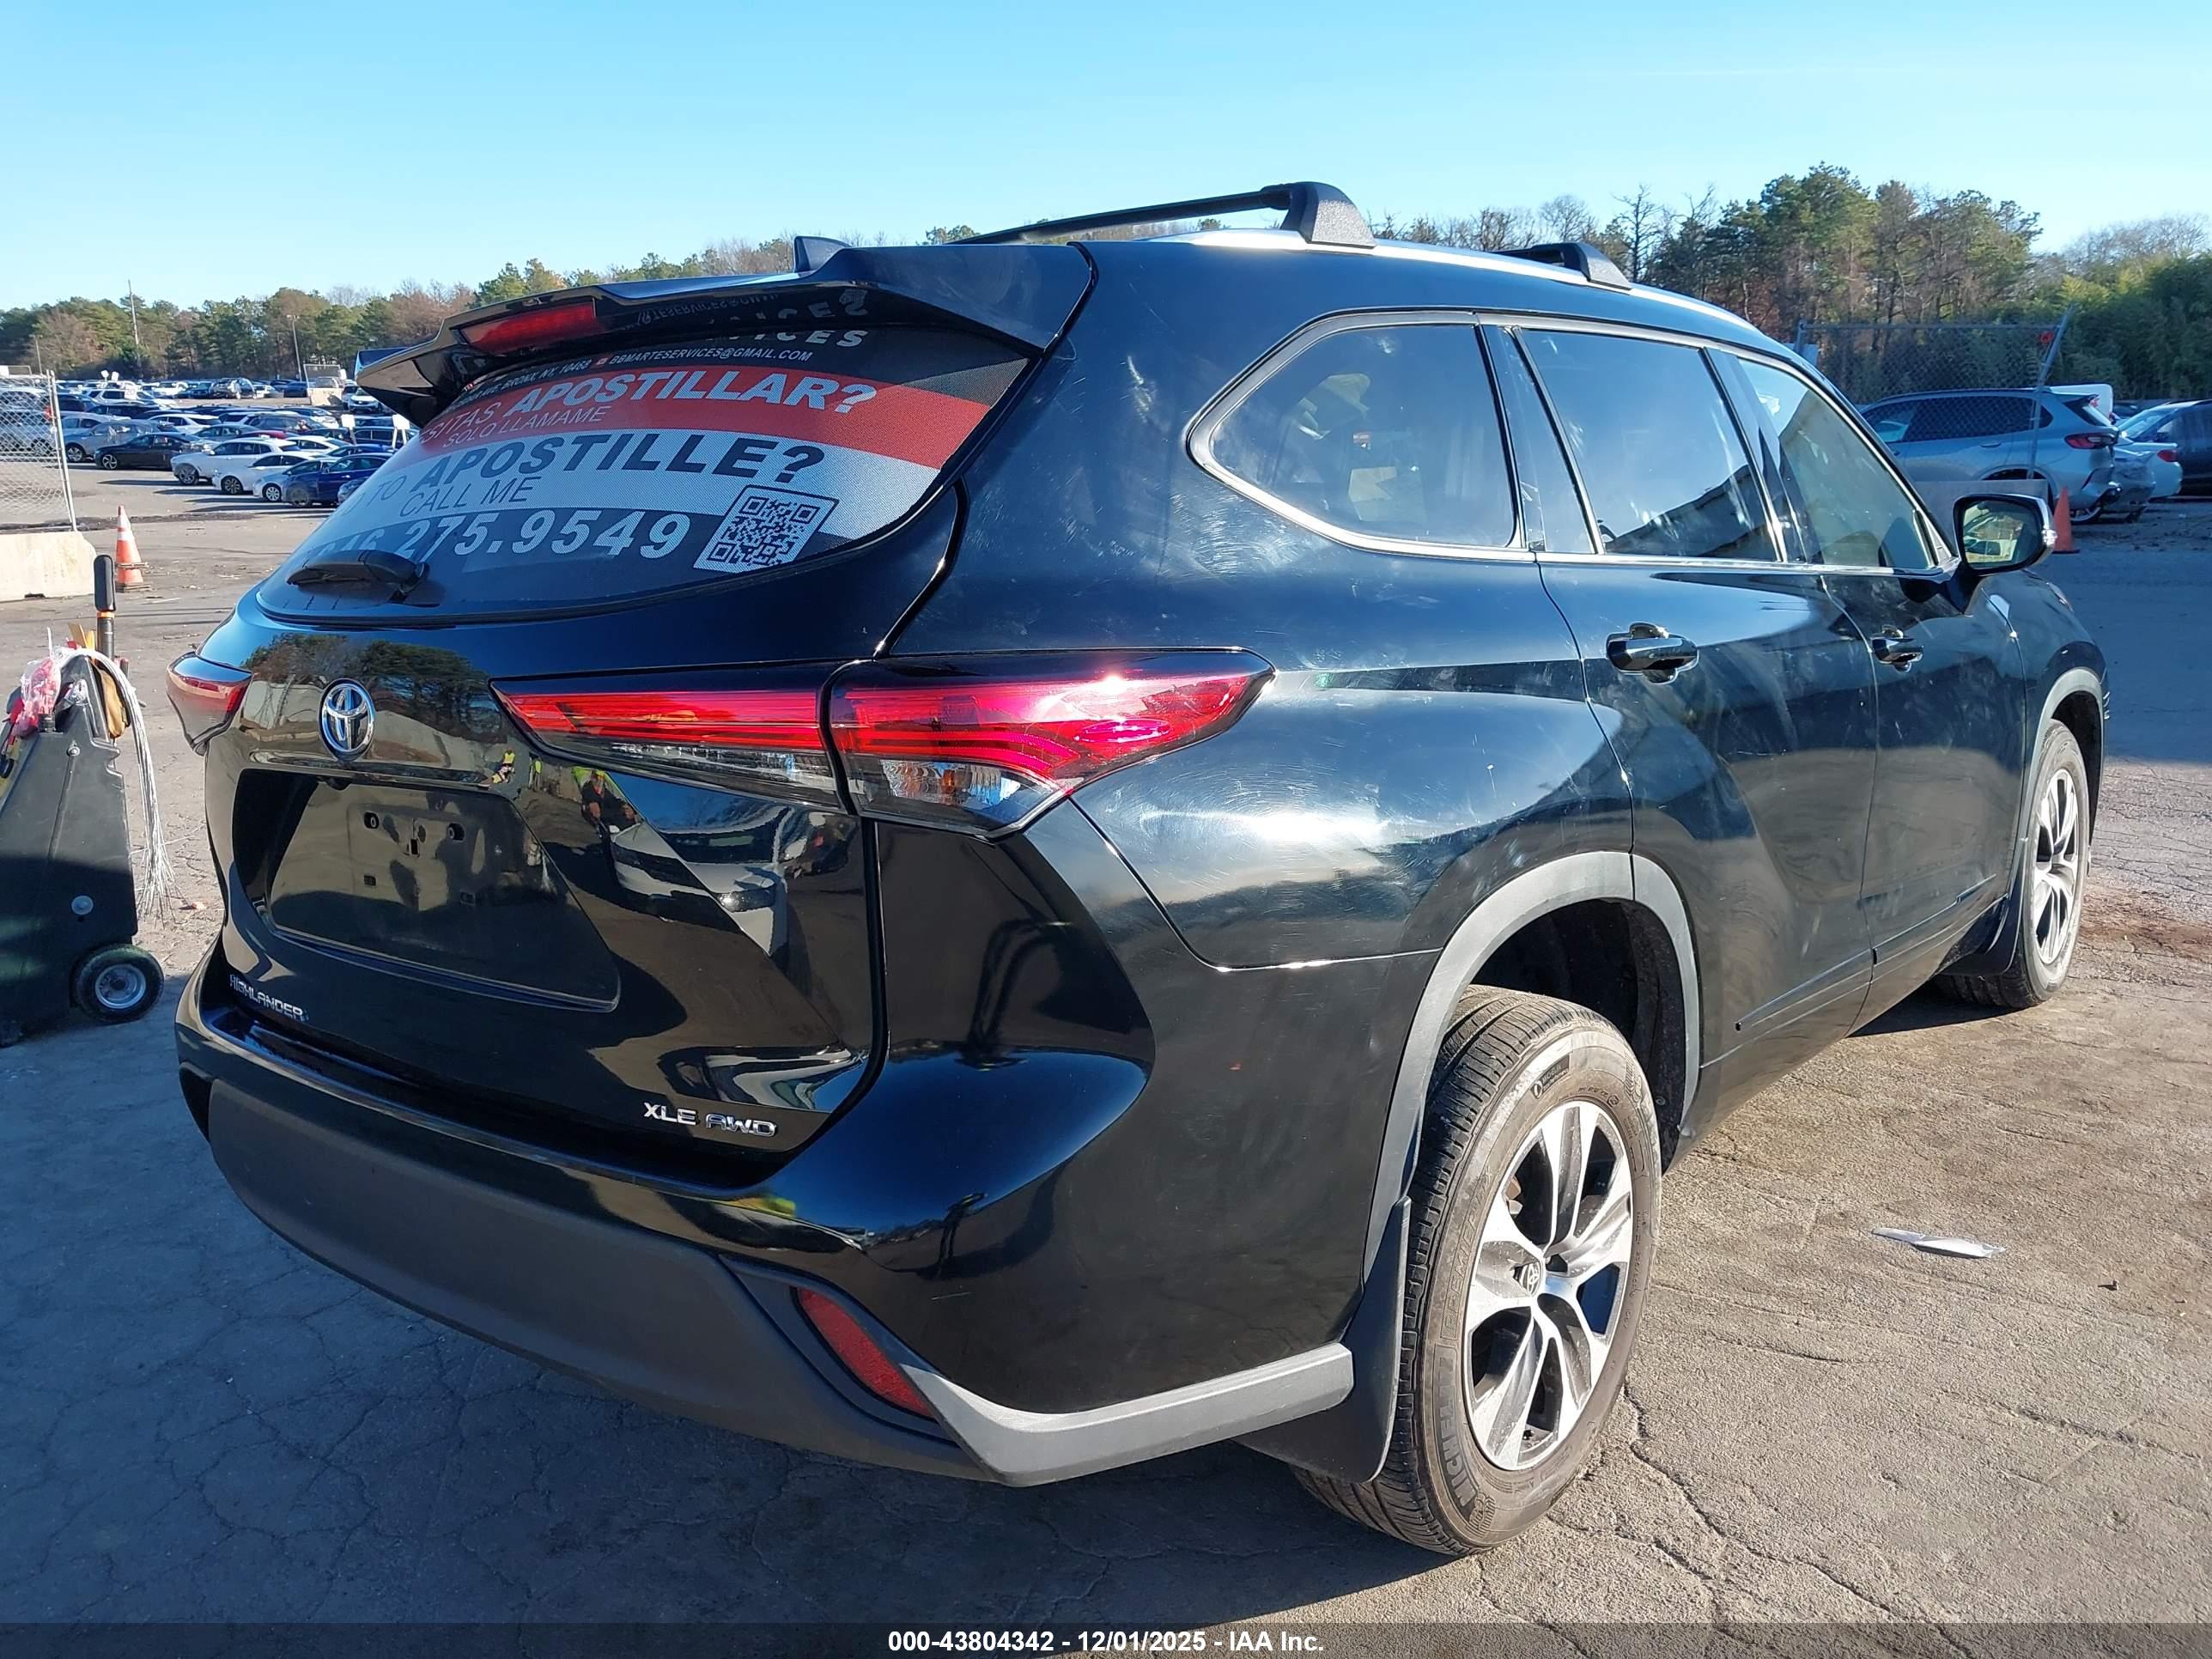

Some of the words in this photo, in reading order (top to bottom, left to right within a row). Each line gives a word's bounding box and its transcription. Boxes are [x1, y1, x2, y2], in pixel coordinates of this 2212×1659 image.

[608, 348, 813, 365] BBMARTESERVICES@GMAIL.COM
[502, 370, 878, 415] APOSTILLAR?
[441, 422, 497, 448] SOLO
[499, 406, 610, 434] LLAMAME
[367, 475, 407, 507] TO
[410, 434, 825, 492] APOSTILLE?
[399, 483, 472, 517] CALL
[480, 475, 542, 505] ME
[229, 974, 305, 1022] HIGHLANDER
[643, 1102, 696, 1127] XLE
[705, 1113, 777, 1138] AWD
[1438, 1356, 1477, 1507] MICHELIN
